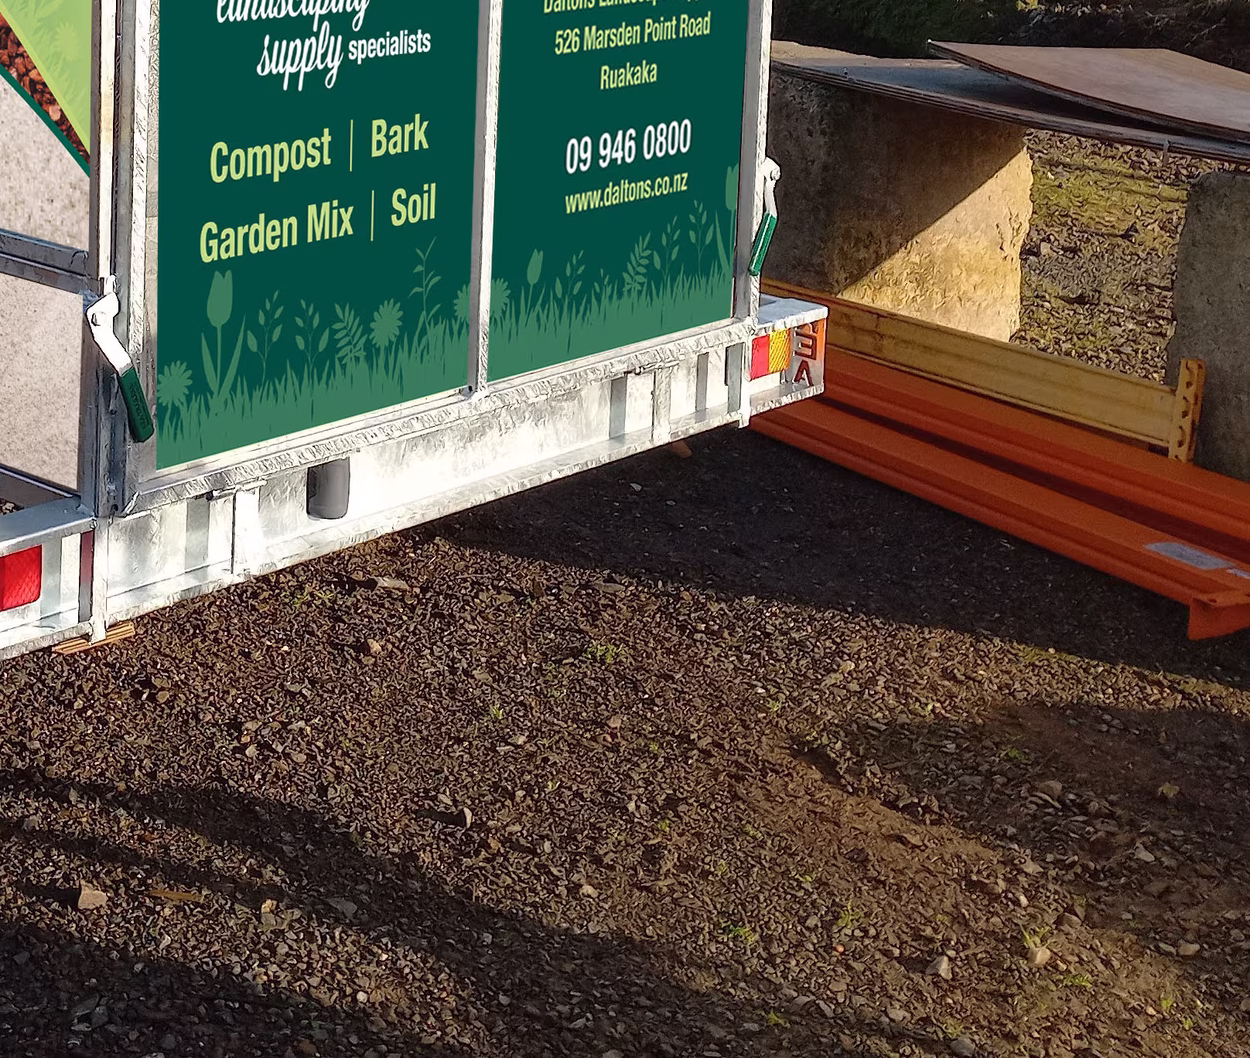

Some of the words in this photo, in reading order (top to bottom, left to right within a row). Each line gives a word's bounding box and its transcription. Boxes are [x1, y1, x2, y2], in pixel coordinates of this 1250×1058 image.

[256, 20, 344, 92] supply
[348, 29, 432, 65] specialists
[554, 28, 580, 55] 526
[583, 20, 640, 51] Marsden
[644, 15, 677, 44] Point
[679, 11, 711, 39] Road
[600, 60, 657, 90] Ruakaka
[210, 128, 332, 183] Compost
[371, 113, 429, 158] Bark
[565, 135, 592, 174] 09
[598, 128, 636, 168] 946
[643, 118, 691, 161] 0800
[565, 169, 688, 214] www.daltons.co.nz
[200, 213, 298, 263] Garden
[307, 199, 354, 243] Mix
[391, 182, 436, 227] Soil
